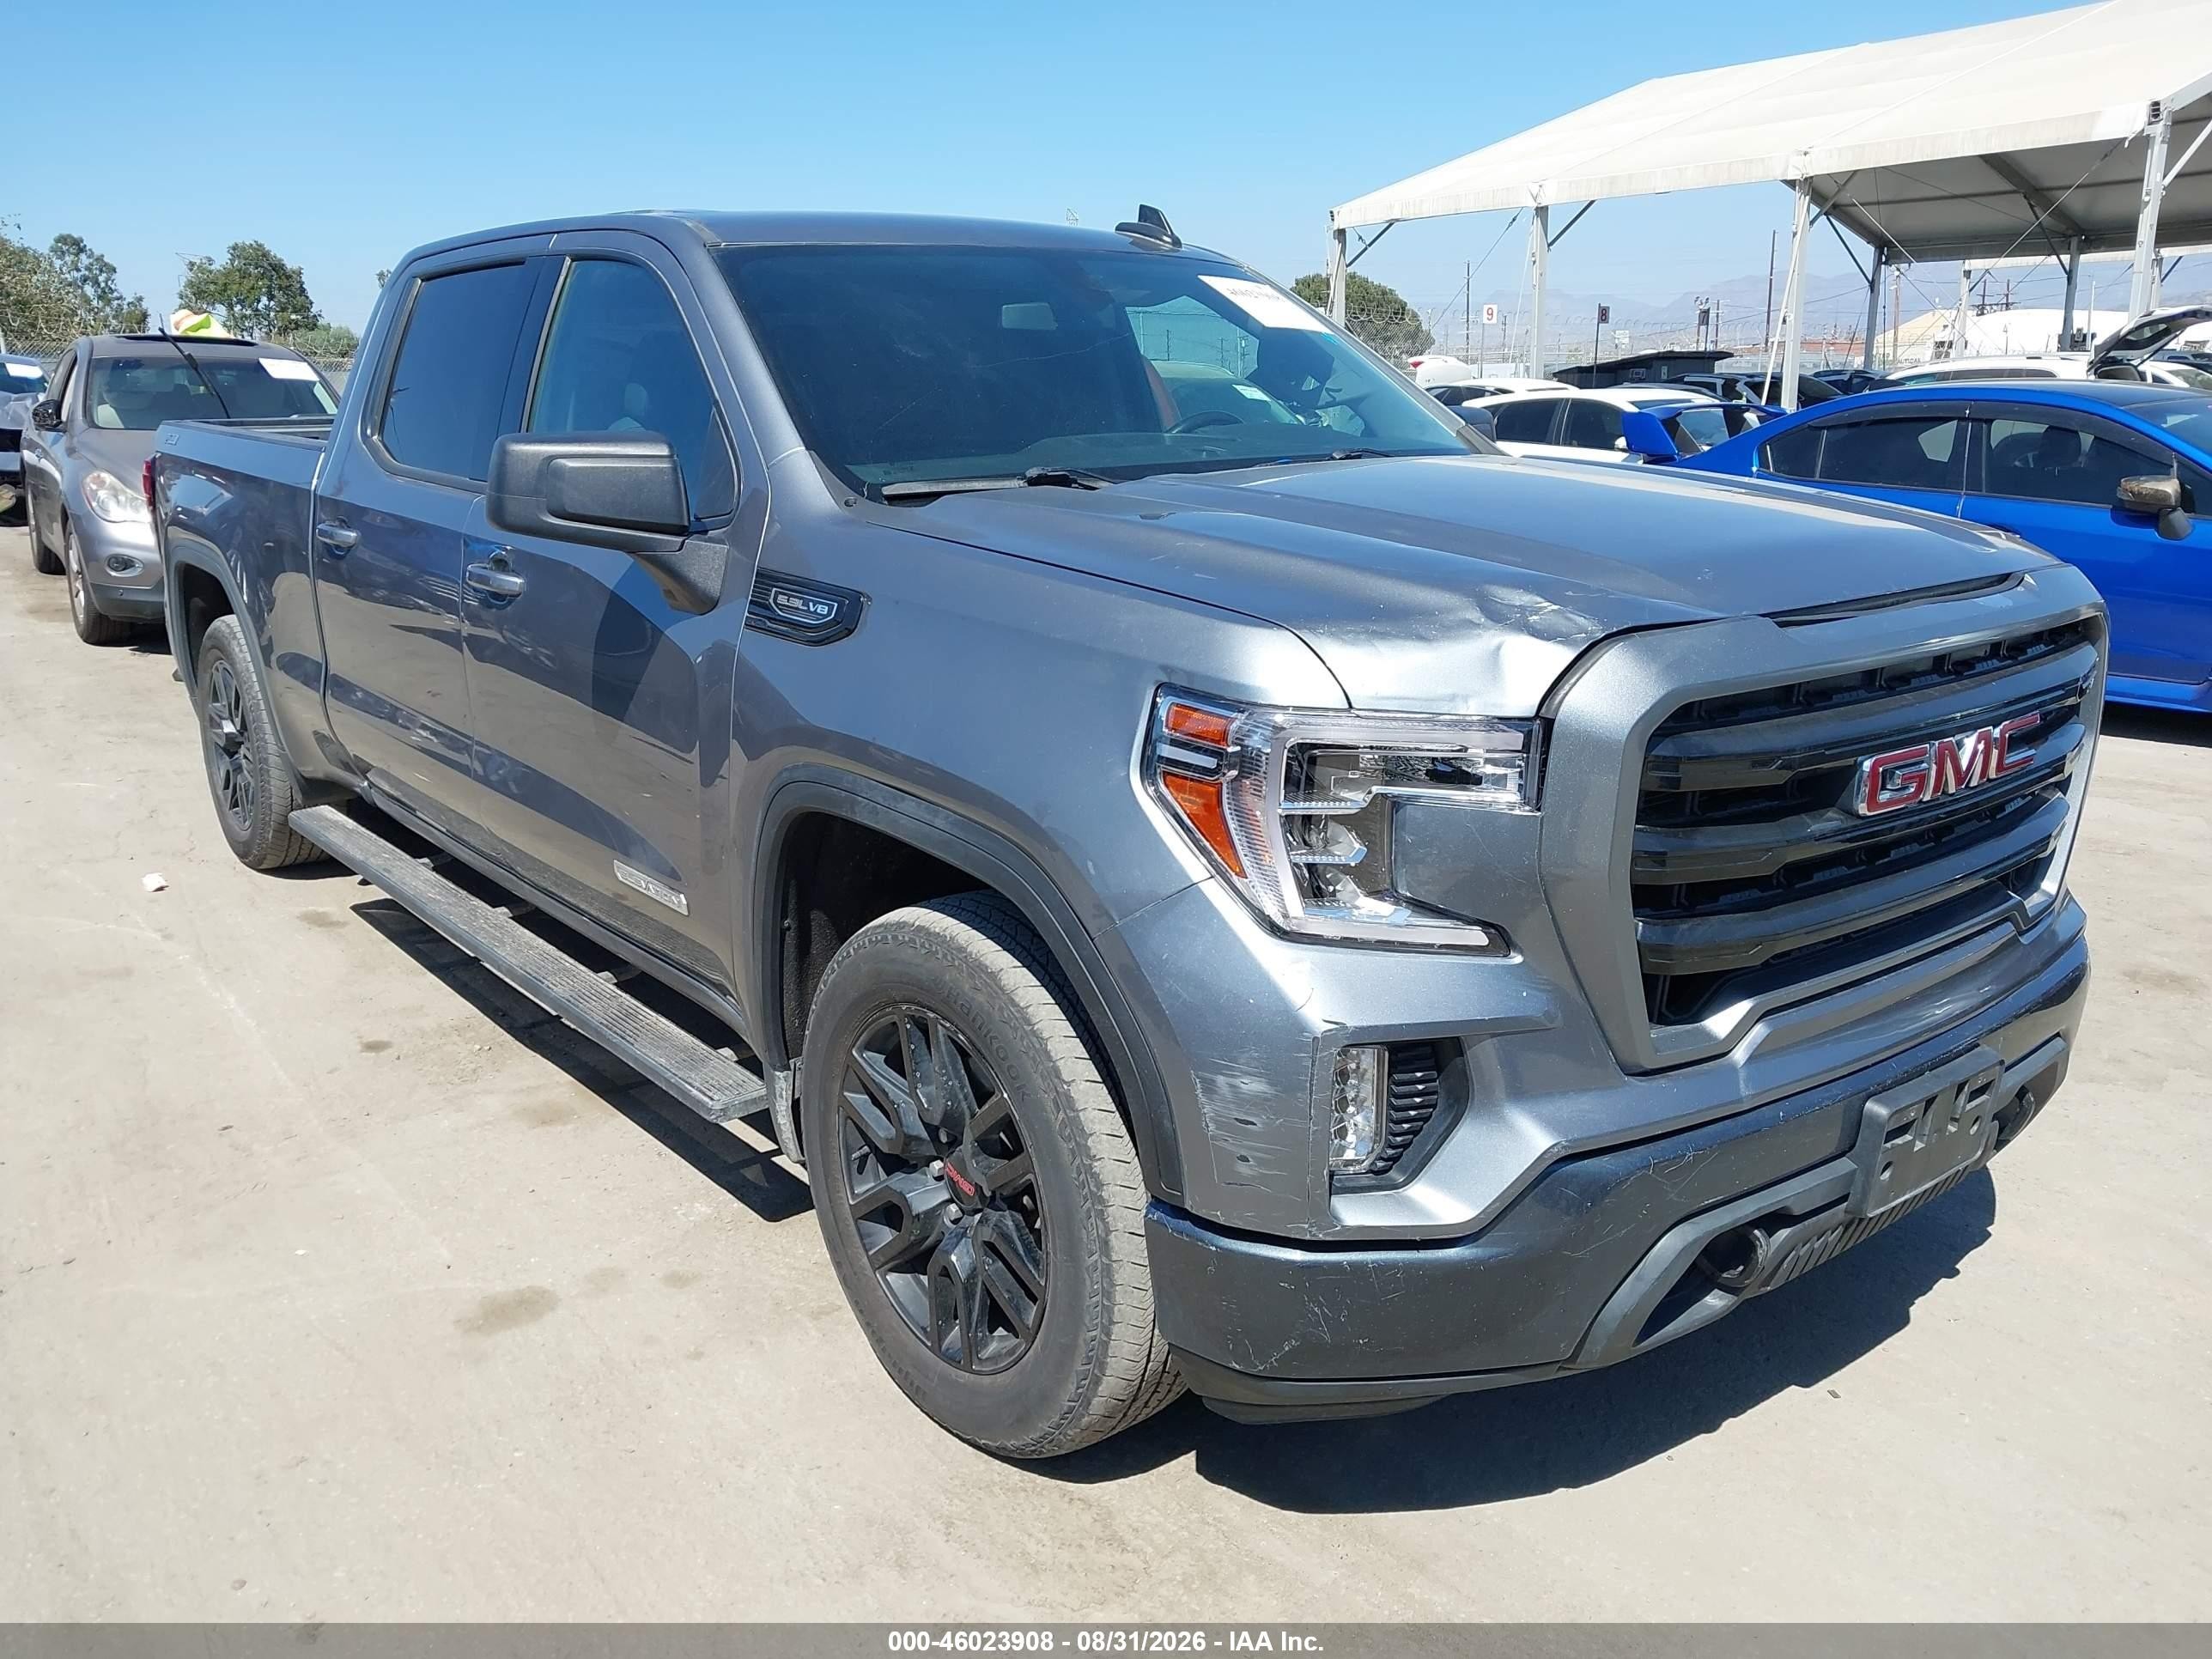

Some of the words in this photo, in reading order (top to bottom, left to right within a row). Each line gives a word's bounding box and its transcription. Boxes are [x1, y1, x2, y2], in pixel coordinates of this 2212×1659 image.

[1486, 307, 1494, 321] 9
[1600, 307, 1607, 322] 8
[1701, 309, 1708, 324] 7
[808, 602, 829, 615] V8
[1854, 714, 2041, 817] GMC
[945, 1161, 975, 1196] GMC
